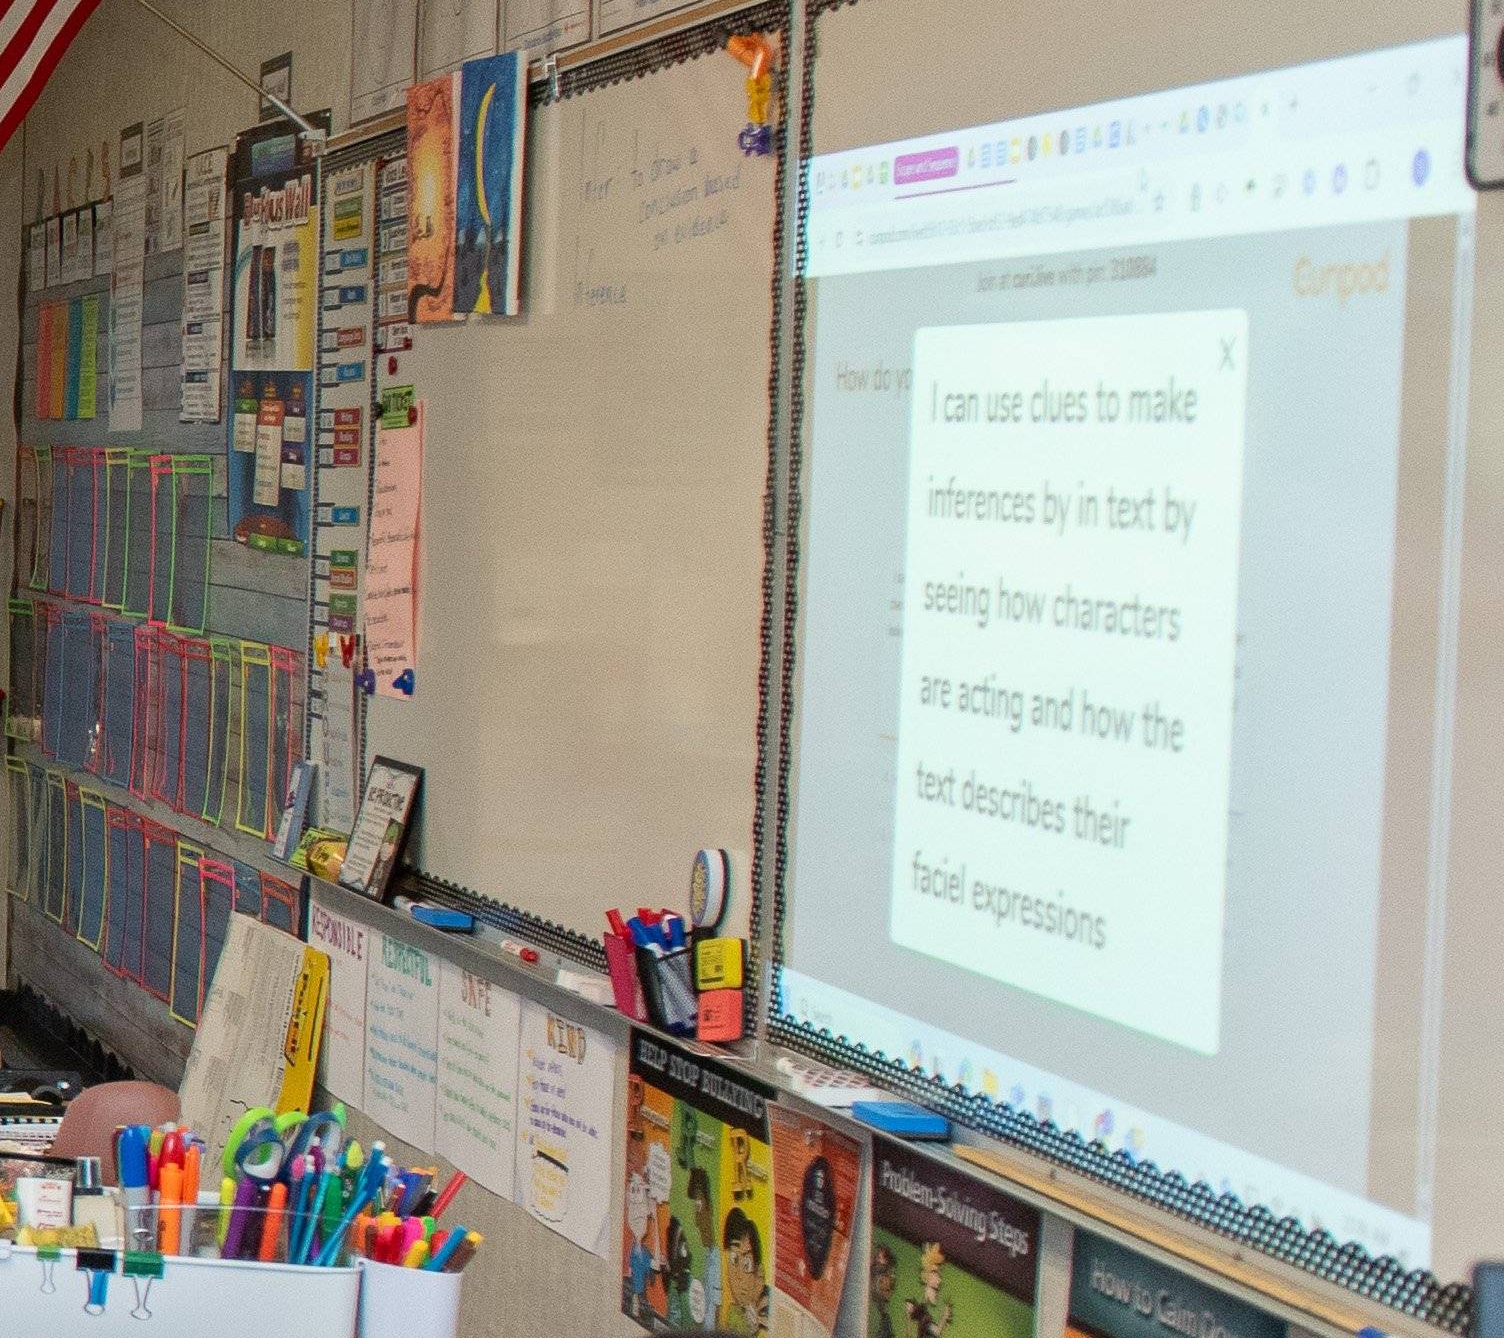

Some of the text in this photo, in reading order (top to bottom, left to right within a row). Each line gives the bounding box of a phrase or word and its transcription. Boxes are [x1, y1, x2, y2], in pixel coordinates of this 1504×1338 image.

[835, 364, 892, 393] How do
[943, 387, 980, 424] can
[987, 386, 1023, 424] use
[1029, 378, 1088, 424] clues
[1096, 382, 1121, 424] to
[1128, 376, 1198, 427] make
[927, 474, 1197, 546] inferences by in text by
[923, 572, 1183, 643] seeing how characters
[920, 670, 1187, 755] are acting and how the
[914, 761, 1131, 851] text describes their
[912, 850, 1108, 952] faciel expressions
[546, 1012, 587, 1066] KIND
[639, 1038, 763, 1120] HELP STOP BULLYING
[880, 1160, 1029, 1258] Problem-Solving Steps
[1091, 1259, 1128, 1305] How
[1131, 1279, 1155, 1317] to
